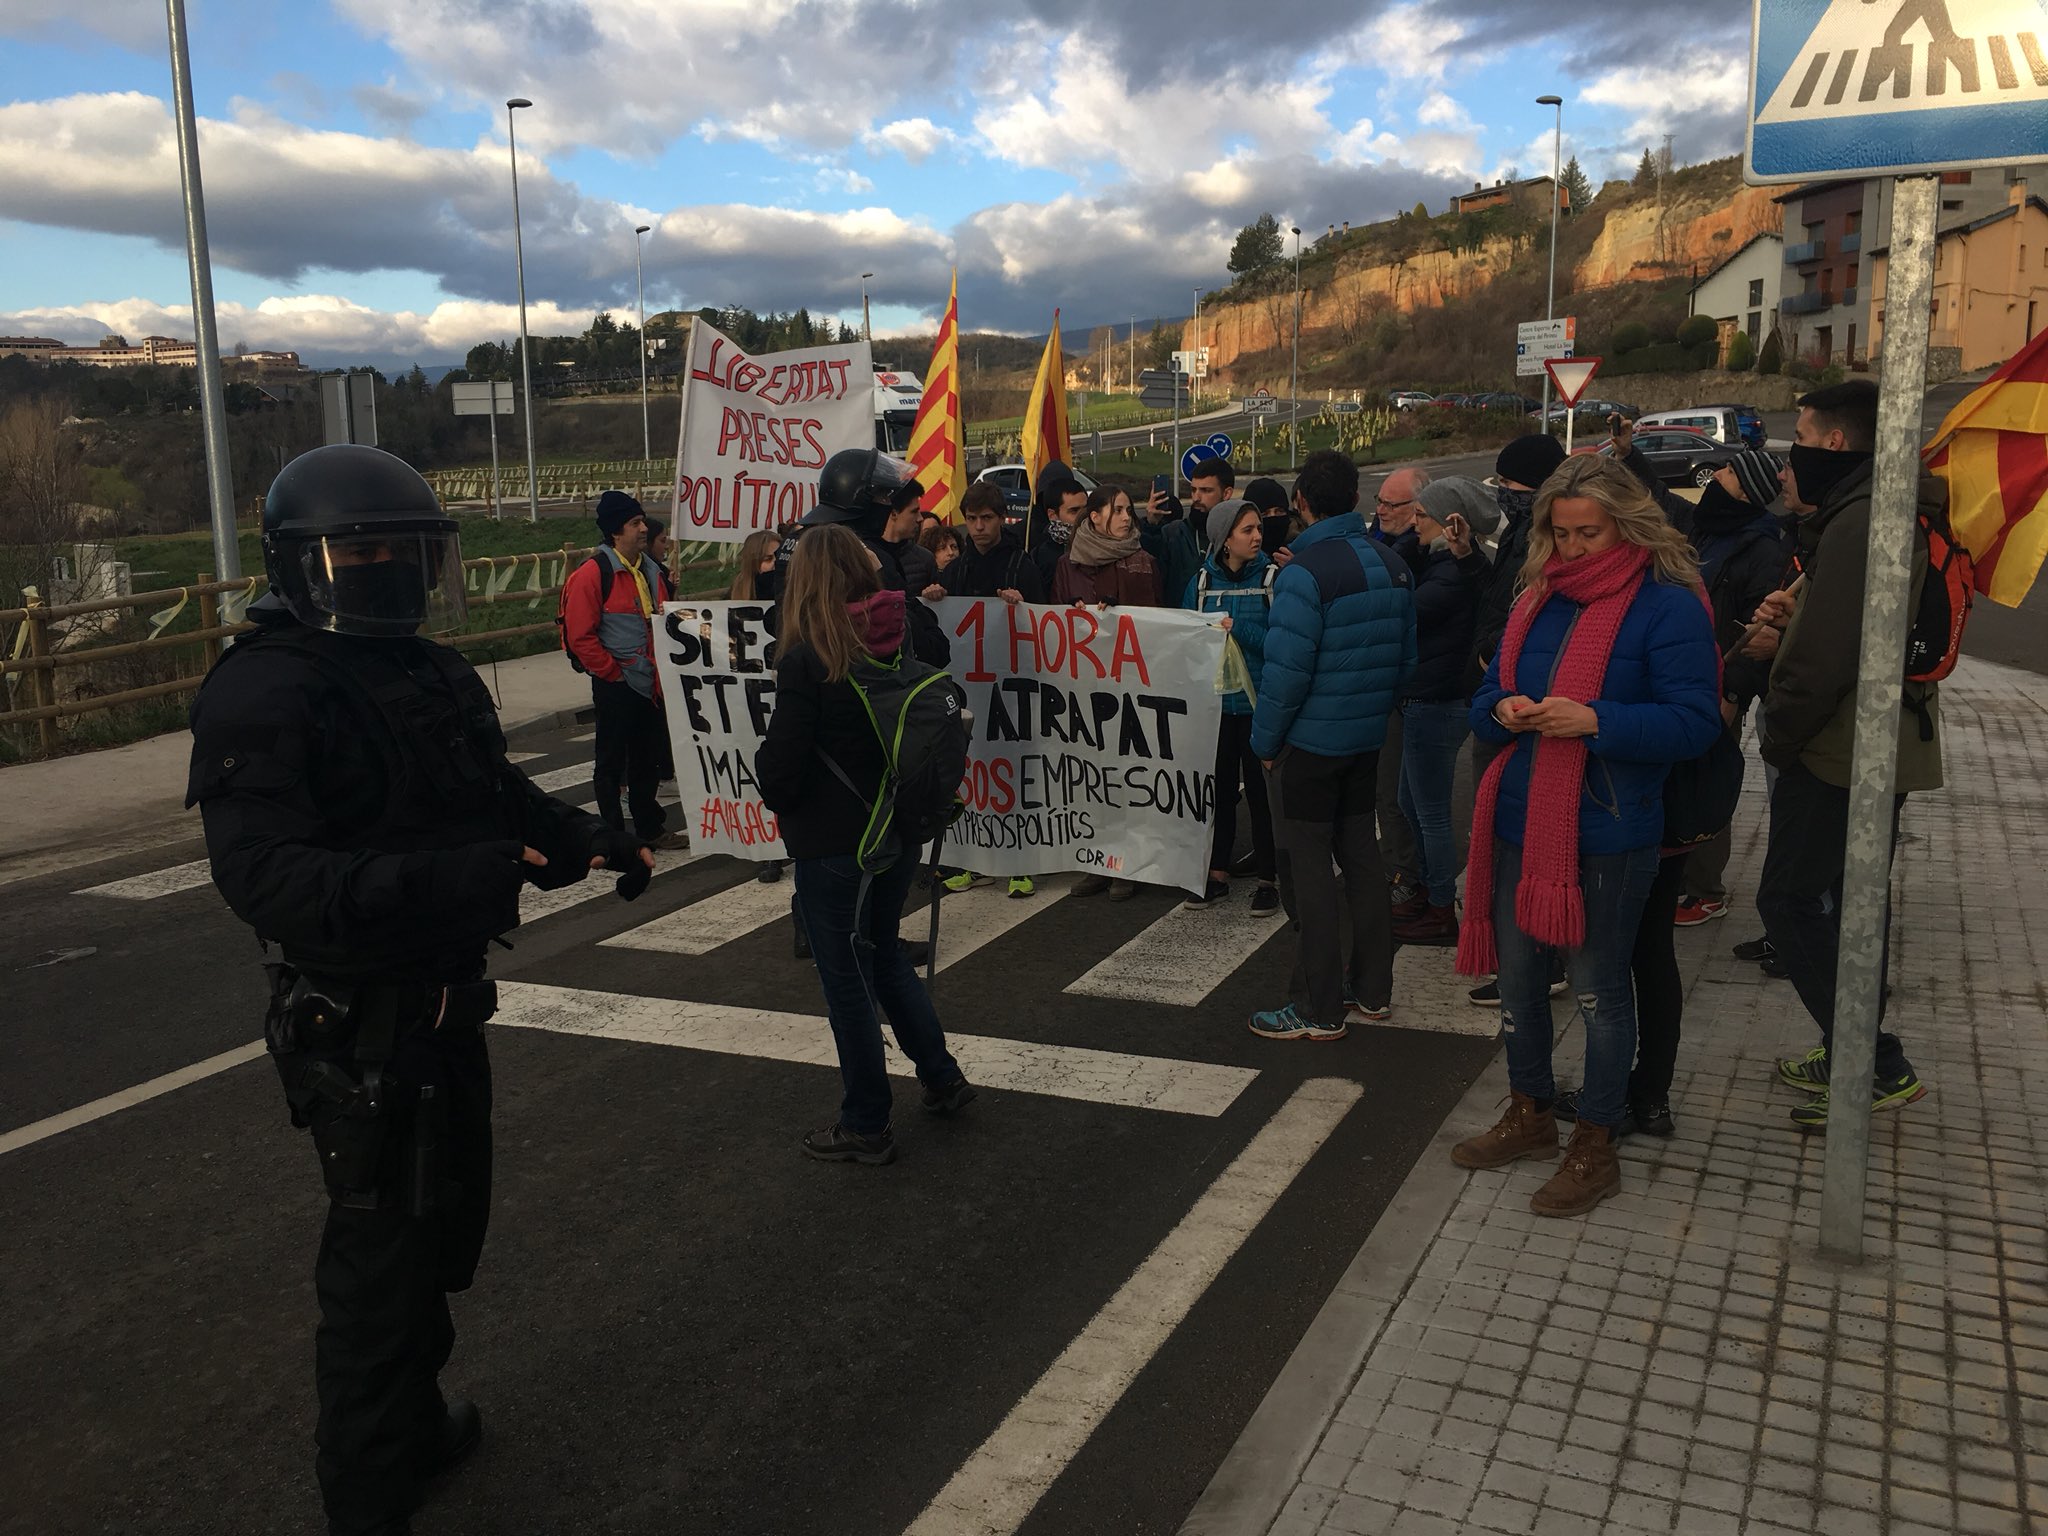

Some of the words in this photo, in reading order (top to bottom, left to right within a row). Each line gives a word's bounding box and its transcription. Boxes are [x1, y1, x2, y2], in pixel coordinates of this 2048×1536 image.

[717, 406, 827, 470] PRESES
[955, 601, 997, 682] 1
[1008, 604, 1151, 687] HORA
[680, 674, 738, 735] ET
[986, 677, 1188, 760] ATRAPAT
[1075, 847, 1105, 867] CDR
